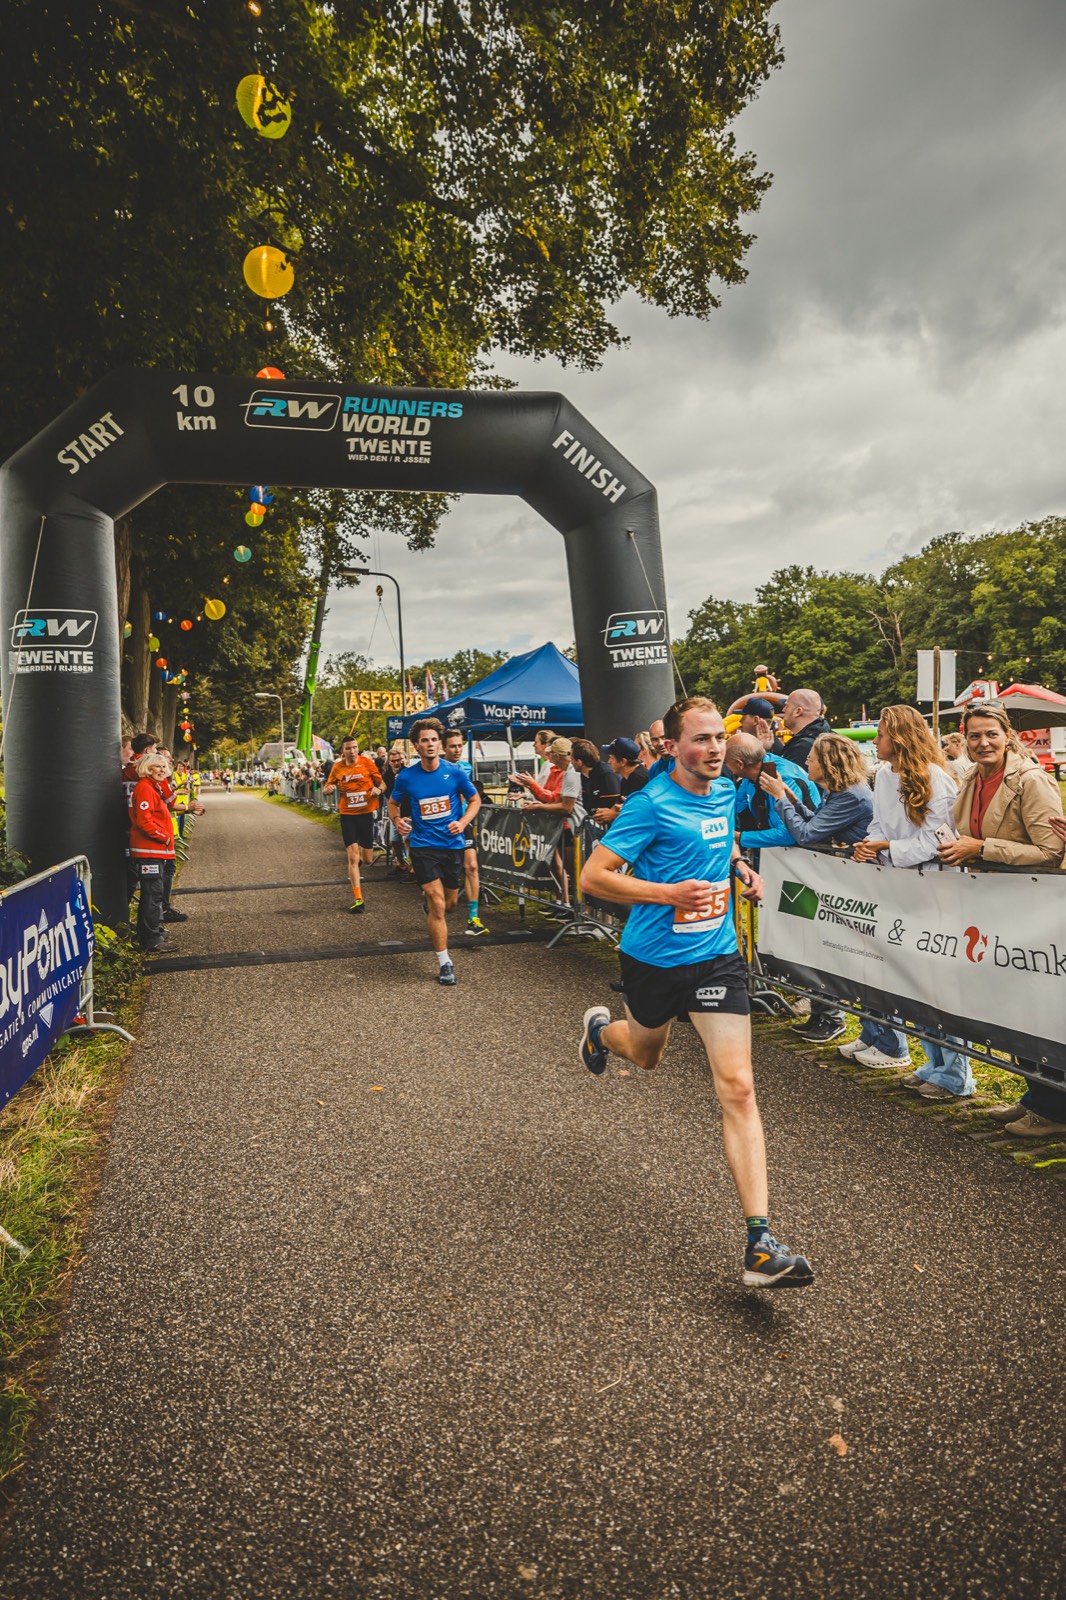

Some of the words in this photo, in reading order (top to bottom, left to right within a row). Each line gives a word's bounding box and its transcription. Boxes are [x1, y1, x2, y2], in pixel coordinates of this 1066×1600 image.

[172, 385, 215, 407] 10
[252, 398, 334, 419] RW
[343, 397, 464, 418] RUNNERS
[177, 411, 217, 430] km
[342, 413, 432, 436] WORLD
[57, 411, 125, 474] START
[346, 438, 432, 455] TWENTE
[552, 430, 627, 503] FINISH
[16, 619, 92, 637] RW
[610, 619, 663, 638] RW
[15, 651, 94, 665] TWENTE
[609, 646, 668, 661] TWENTE
[59, 665, 94, 673] RIJSSEN
[482, 703, 547, 720] WayPoint
[350, 796, 365, 804] 374
[423, 802, 447, 814] 283
[480, 828, 512, 855] Otten
[887, 919, 906, 941] &
[916, 931, 958, 958] asn
[994, 936, 1066, 977] bank
[28, 965, 84, 1018] COMMUNICATIE
